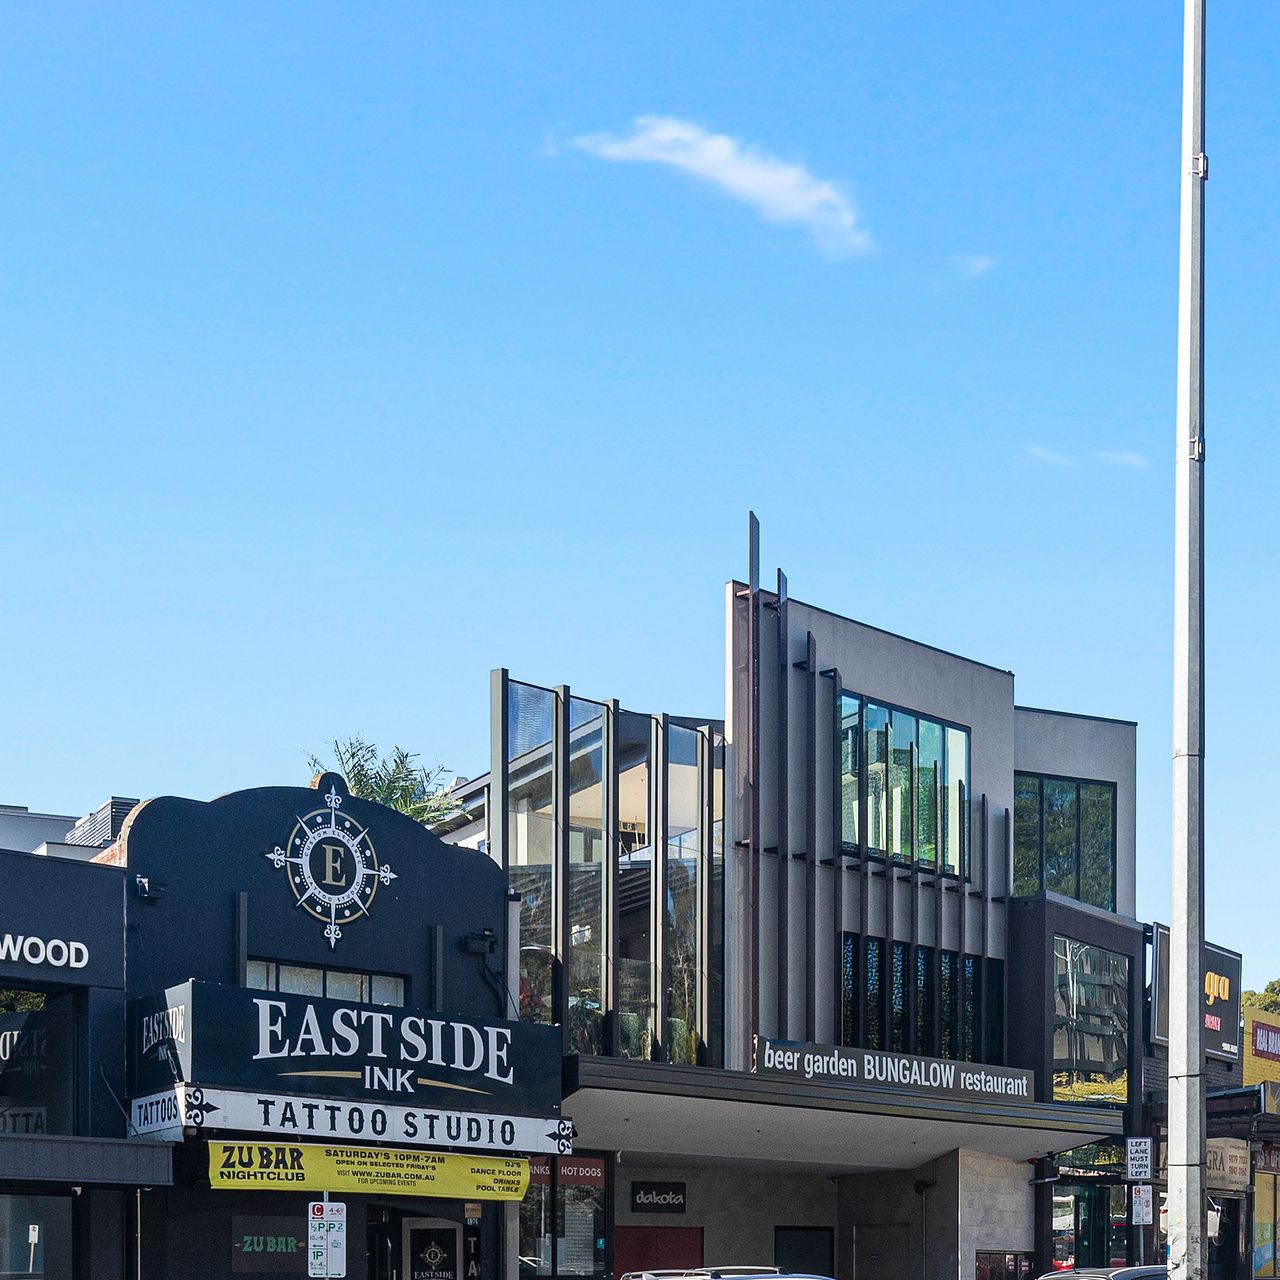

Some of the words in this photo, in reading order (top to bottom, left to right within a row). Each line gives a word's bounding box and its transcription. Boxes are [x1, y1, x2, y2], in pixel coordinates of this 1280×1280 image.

[322, 844, 346, 887] E
[764, 1041, 800, 1071] beer
[804, 1050, 857, 1079] garden
[864, 1054, 955, 1089] BUNGALOW
[960, 1070, 1028, 1097] restaurant
[364, 1065, 415, 1093] INK
[137, 1094, 178, 1127] TATTOOS
[257, 1098, 388, 1137] TATTOO
[403, 1112, 516, 1146] STUDIO
[221, 1145, 254, 1169] ZU
[257, 1146, 305, 1170] BAR
[325, 1149, 390, 1160] SATURDAY'S
[393, 1153, 446, 1164] 10PM-7AM
[219, 1170, 305, 1181] NIGHTCLUB
[351, 1170, 435, 1181] WWW.ZUBAR.COM.AU
[498, 1169, 522, 1177] FLOOR
[561, 1166, 577, 1175] HOT
[579, 1167, 602, 1177] DOGS
[369, 1178, 396, 1186] UPCOMING
[476, 1184, 496, 1192] POOL
[498, 1185, 520, 1193] TABLE
[636, 1190, 684, 1204] dakota
[242, 1235, 264, 1252] ZU
[266, 1236, 298, 1253] BAR
[312, 1251, 324, 1260] 1P
